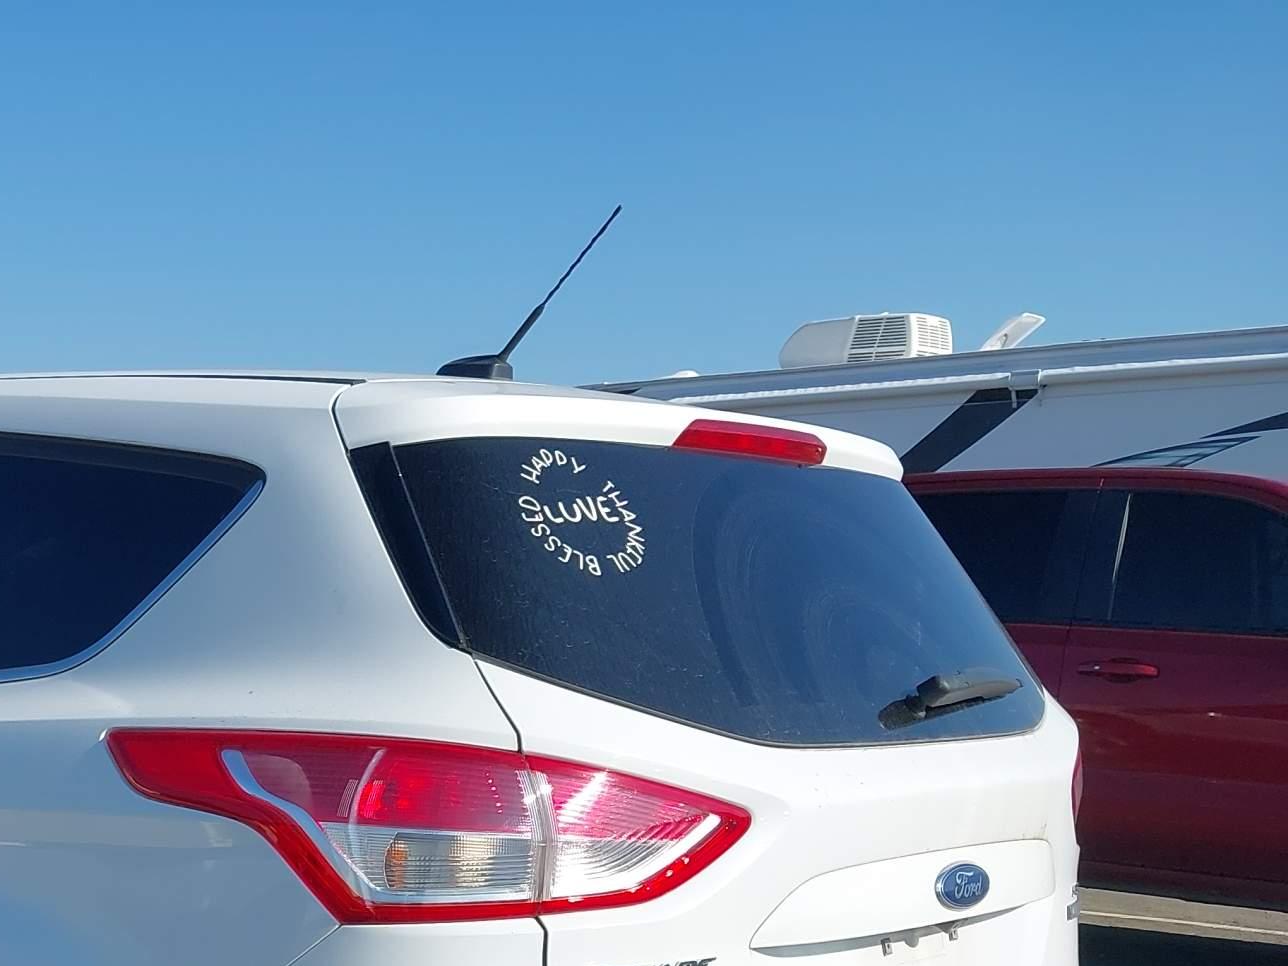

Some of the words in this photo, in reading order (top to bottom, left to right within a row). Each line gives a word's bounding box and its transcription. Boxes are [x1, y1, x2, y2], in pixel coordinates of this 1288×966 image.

[520, 448, 586, 484] HAPPY
[518, 495, 602, 576] BLESSED
[602, 480, 646, 573] THANKFUL
[955, 871, 983, 899] Ford
